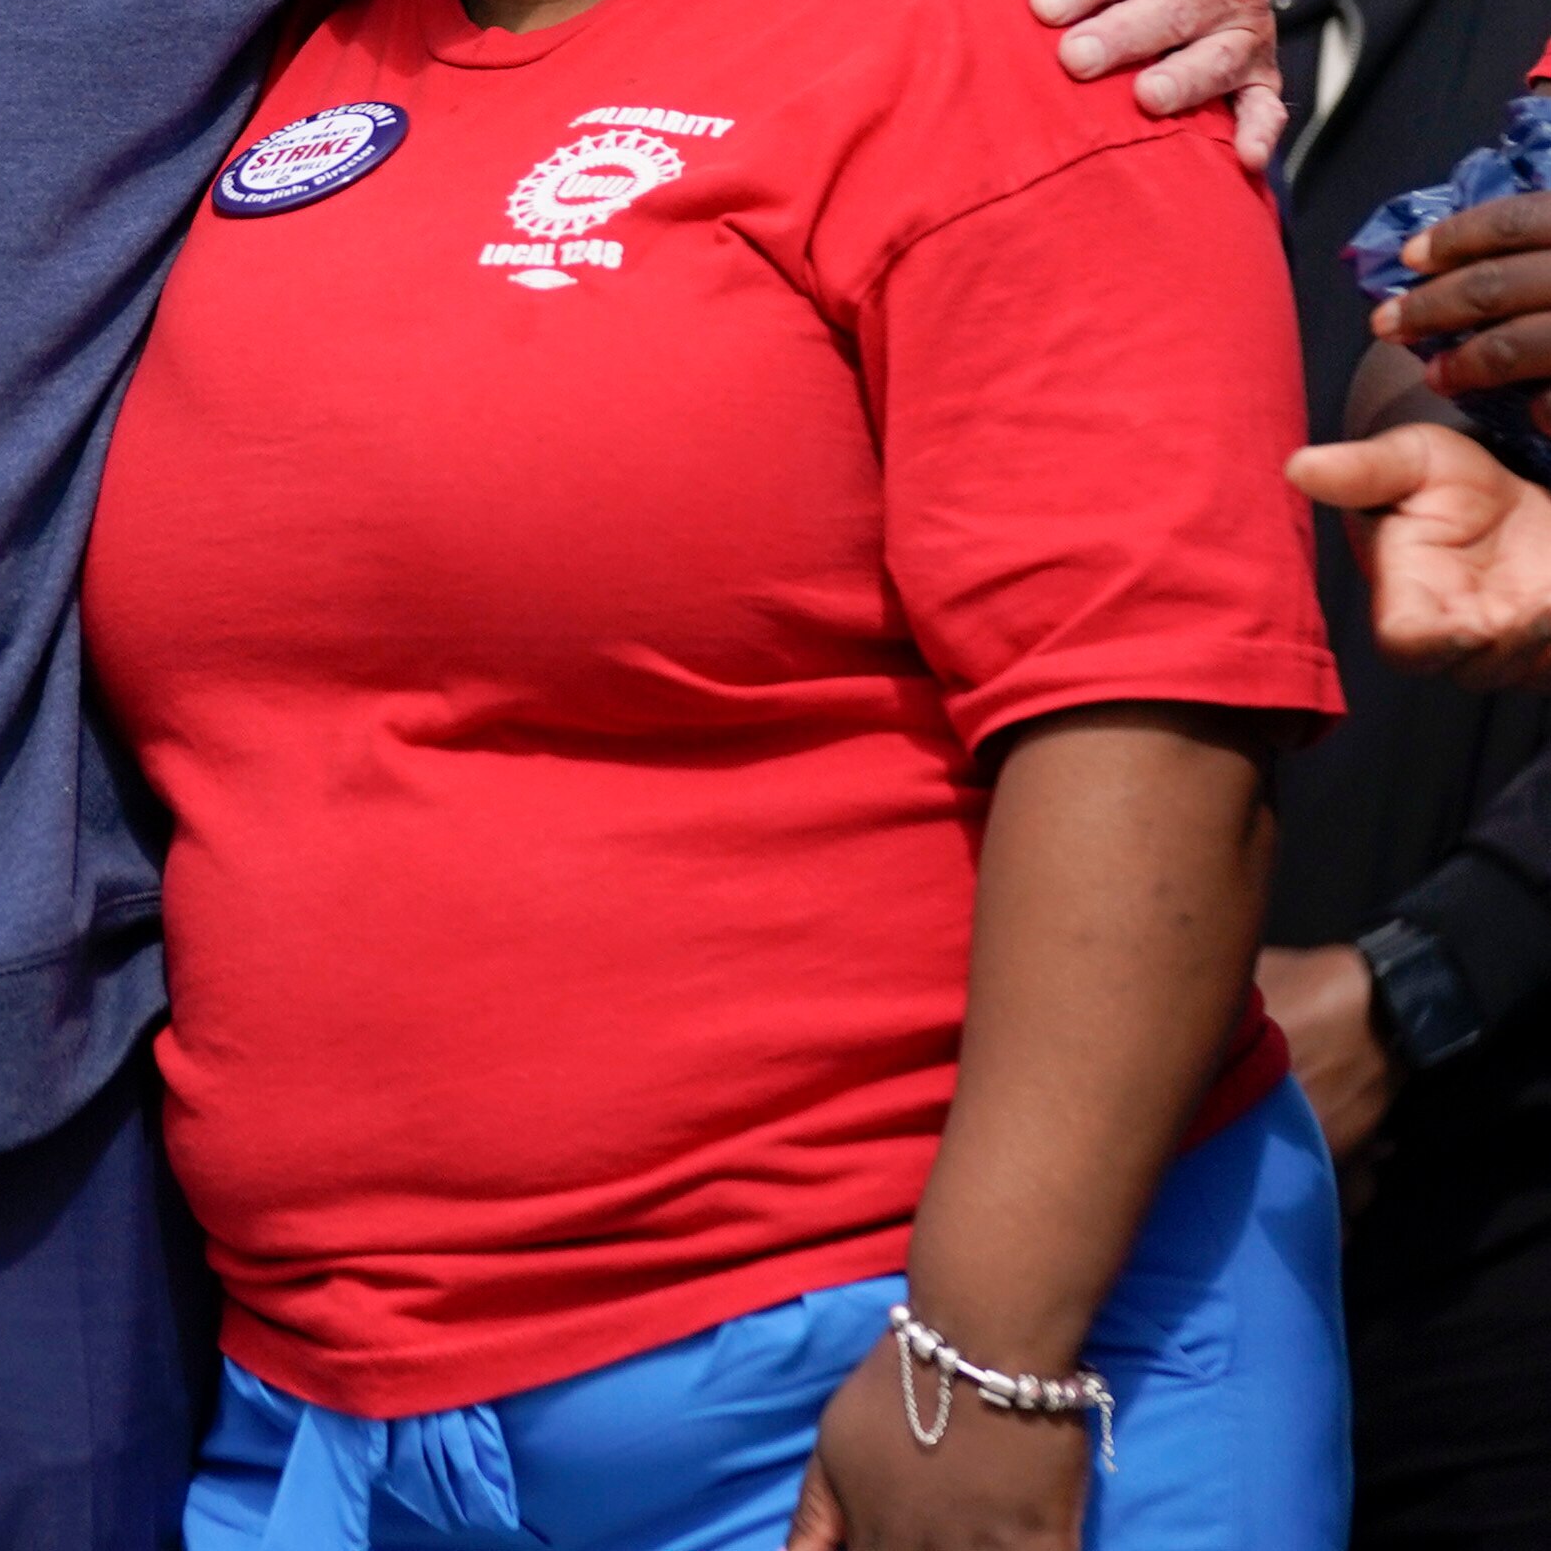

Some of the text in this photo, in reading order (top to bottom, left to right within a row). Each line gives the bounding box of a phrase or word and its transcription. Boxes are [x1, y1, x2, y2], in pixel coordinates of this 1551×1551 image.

[251, 118, 307, 150] UAW
[316, 103, 395, 123] REGION
[248, 135, 359, 171] STRIKE
[313, 144, 377, 186] Director
[250, 169, 280, 182] BUT
[557, 173, 637, 198] UAW
[478, 242, 556, 266] LOCAL
